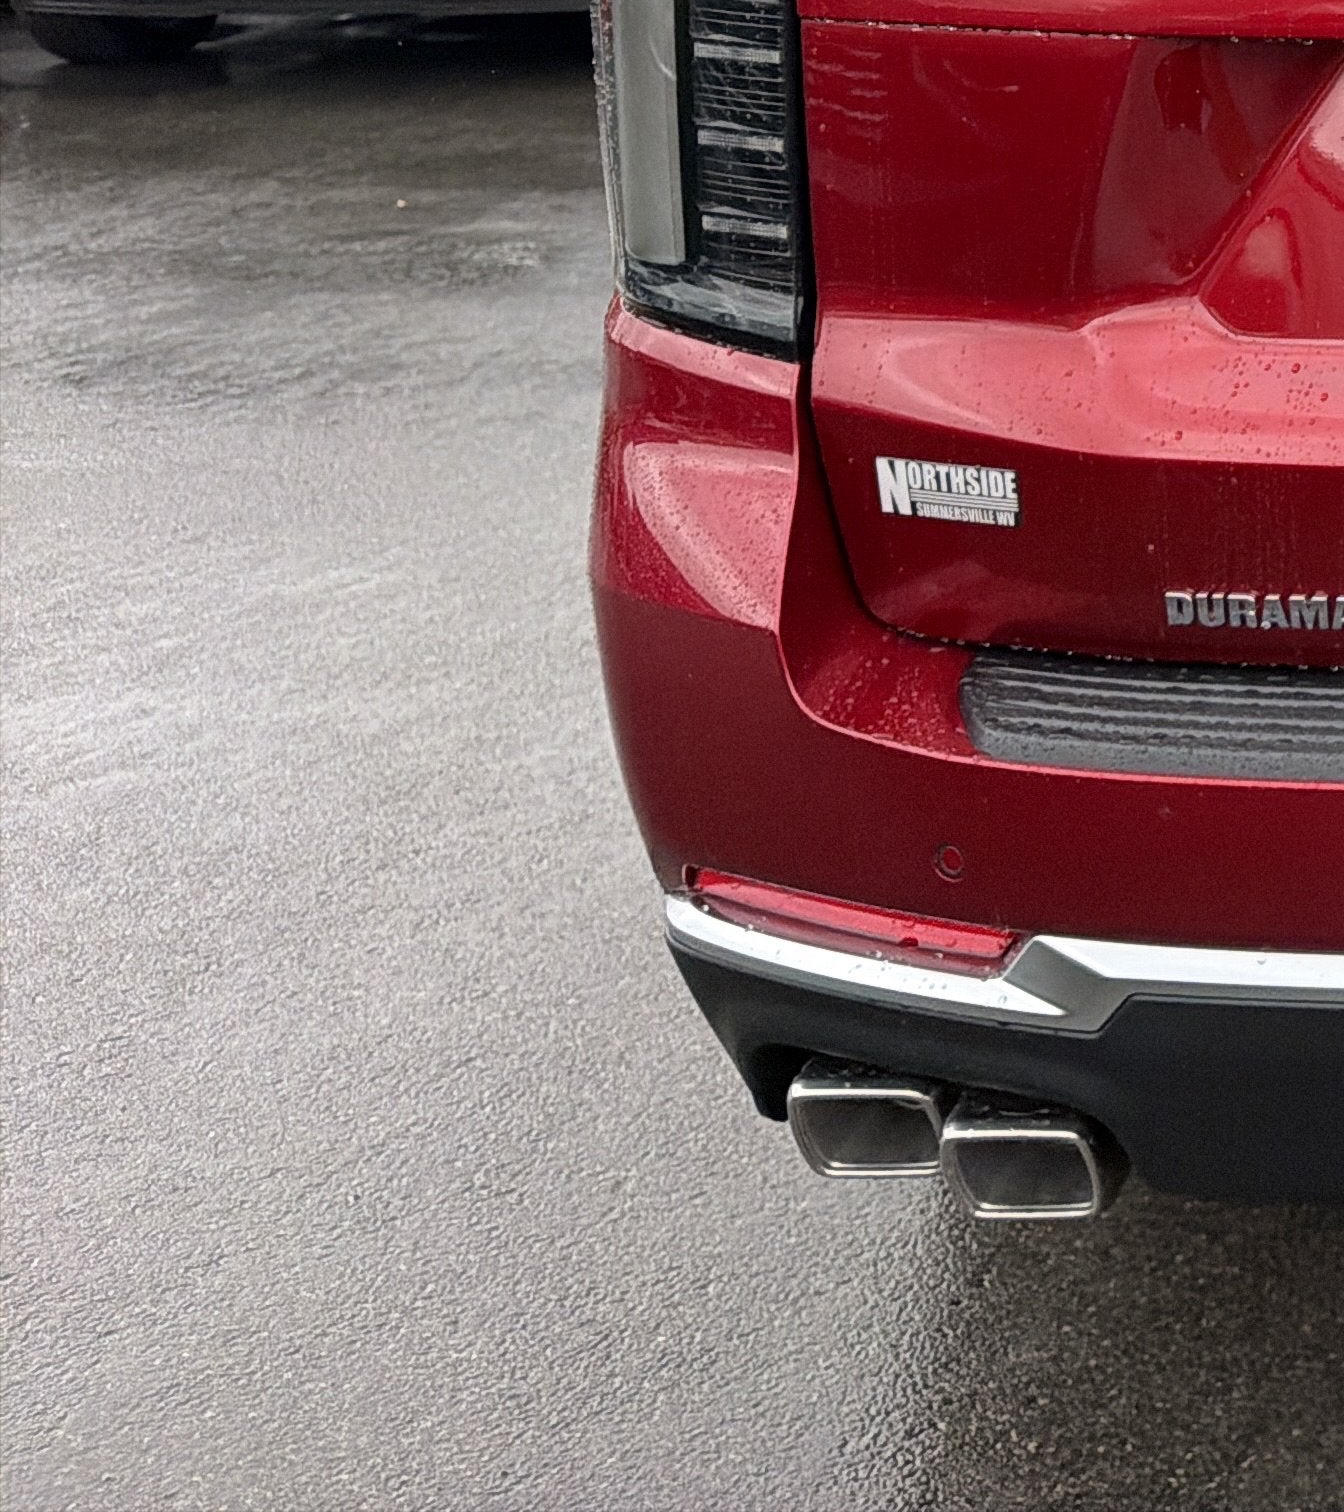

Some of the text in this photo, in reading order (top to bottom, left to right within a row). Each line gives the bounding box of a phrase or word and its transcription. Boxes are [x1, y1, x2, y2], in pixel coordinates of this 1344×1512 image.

[875, 456, 1018, 516] NORTHSIDE
[915, 501, 1016, 527] SUMMERSVILLE WV
